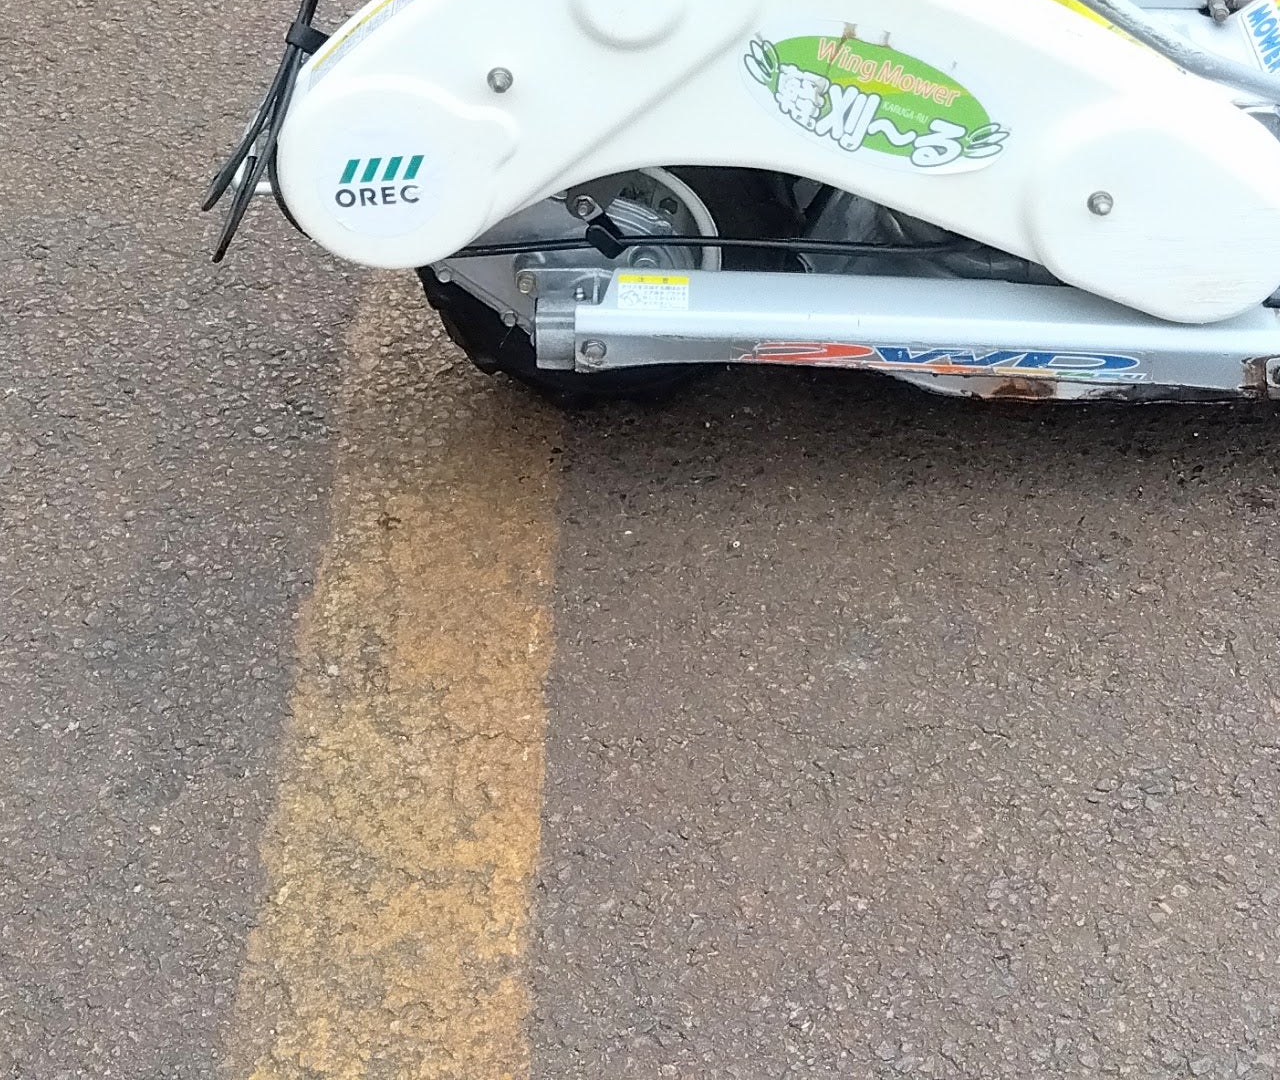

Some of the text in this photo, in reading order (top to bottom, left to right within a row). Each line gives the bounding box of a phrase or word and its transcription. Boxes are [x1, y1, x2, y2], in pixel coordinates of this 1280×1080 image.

[817, 37, 962, 108] Wing Mower
[335, 185, 420, 208] OREC
